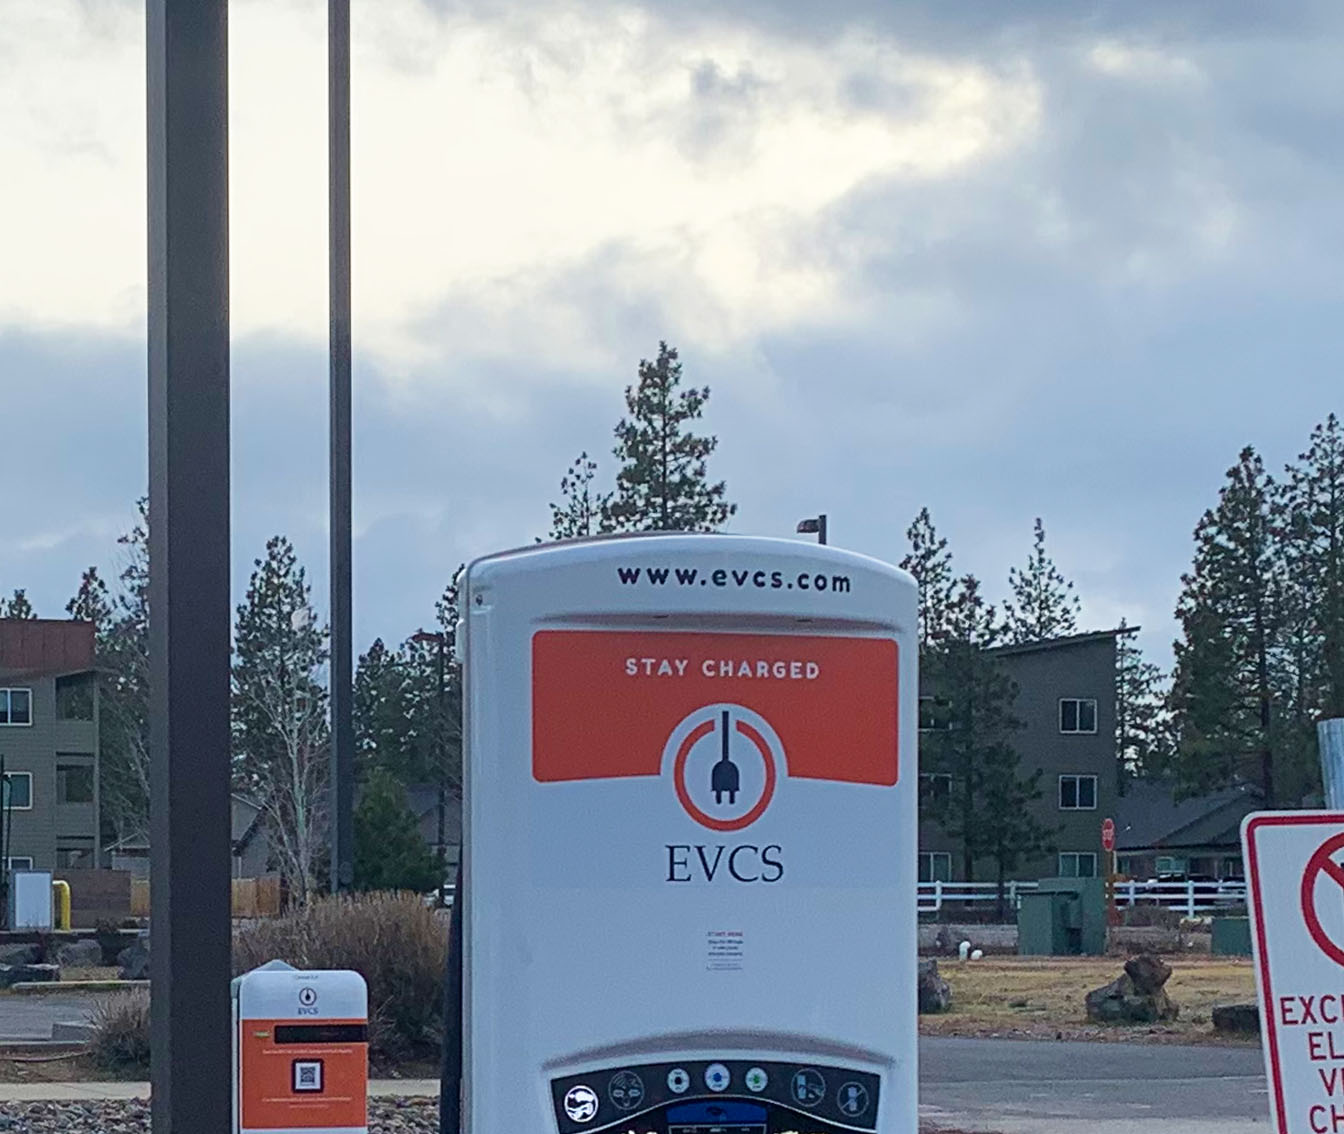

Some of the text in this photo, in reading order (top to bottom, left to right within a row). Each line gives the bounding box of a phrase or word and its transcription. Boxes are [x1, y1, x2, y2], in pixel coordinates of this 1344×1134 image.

[617, 567, 851, 593] www.evcs.com
[625, 658, 820, 680] STAY CHARGED
[664, 844, 784, 882] EVCS
